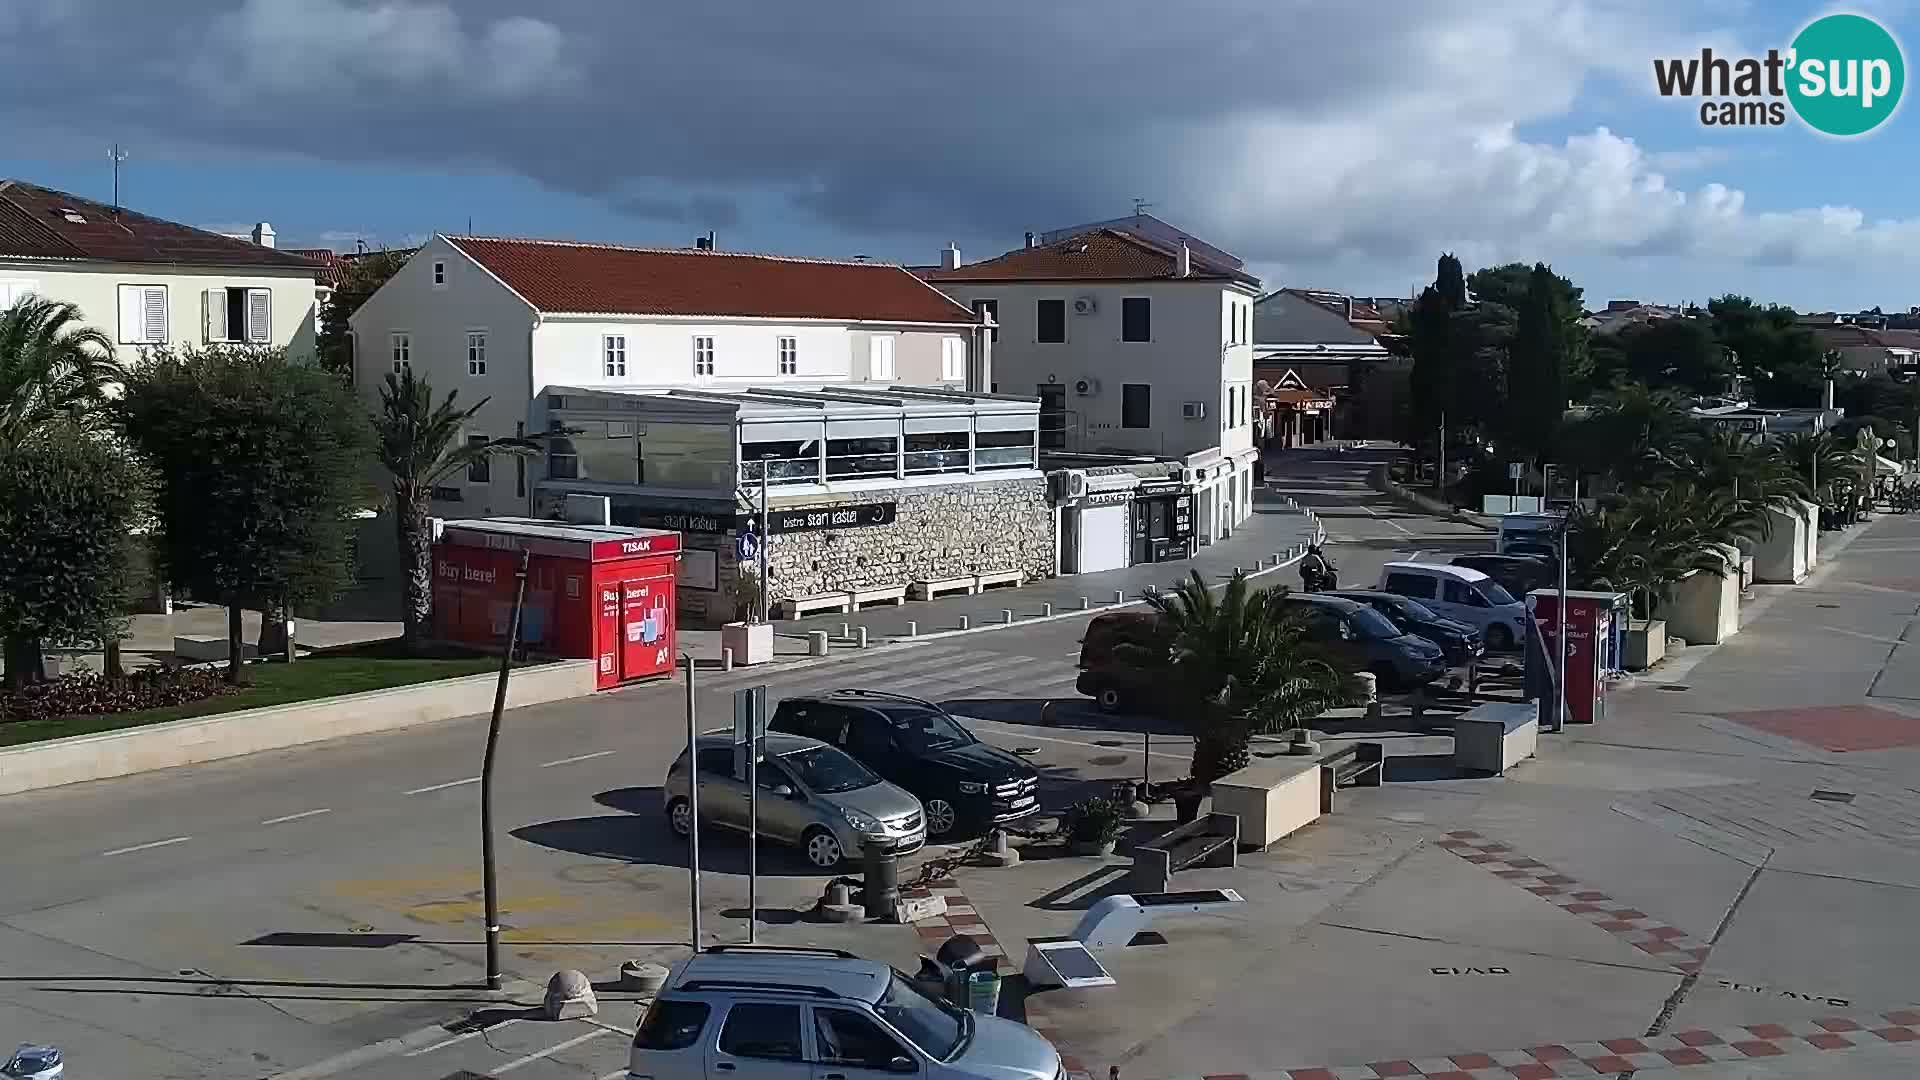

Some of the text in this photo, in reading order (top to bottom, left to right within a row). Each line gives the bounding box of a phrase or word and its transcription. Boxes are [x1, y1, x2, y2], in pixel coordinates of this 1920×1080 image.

[783, 516, 805, 528] bistro
[622, 540, 651, 553] TISAK
[439, 559, 497, 585] Buy here!
[626, 585, 649, 600] here!
